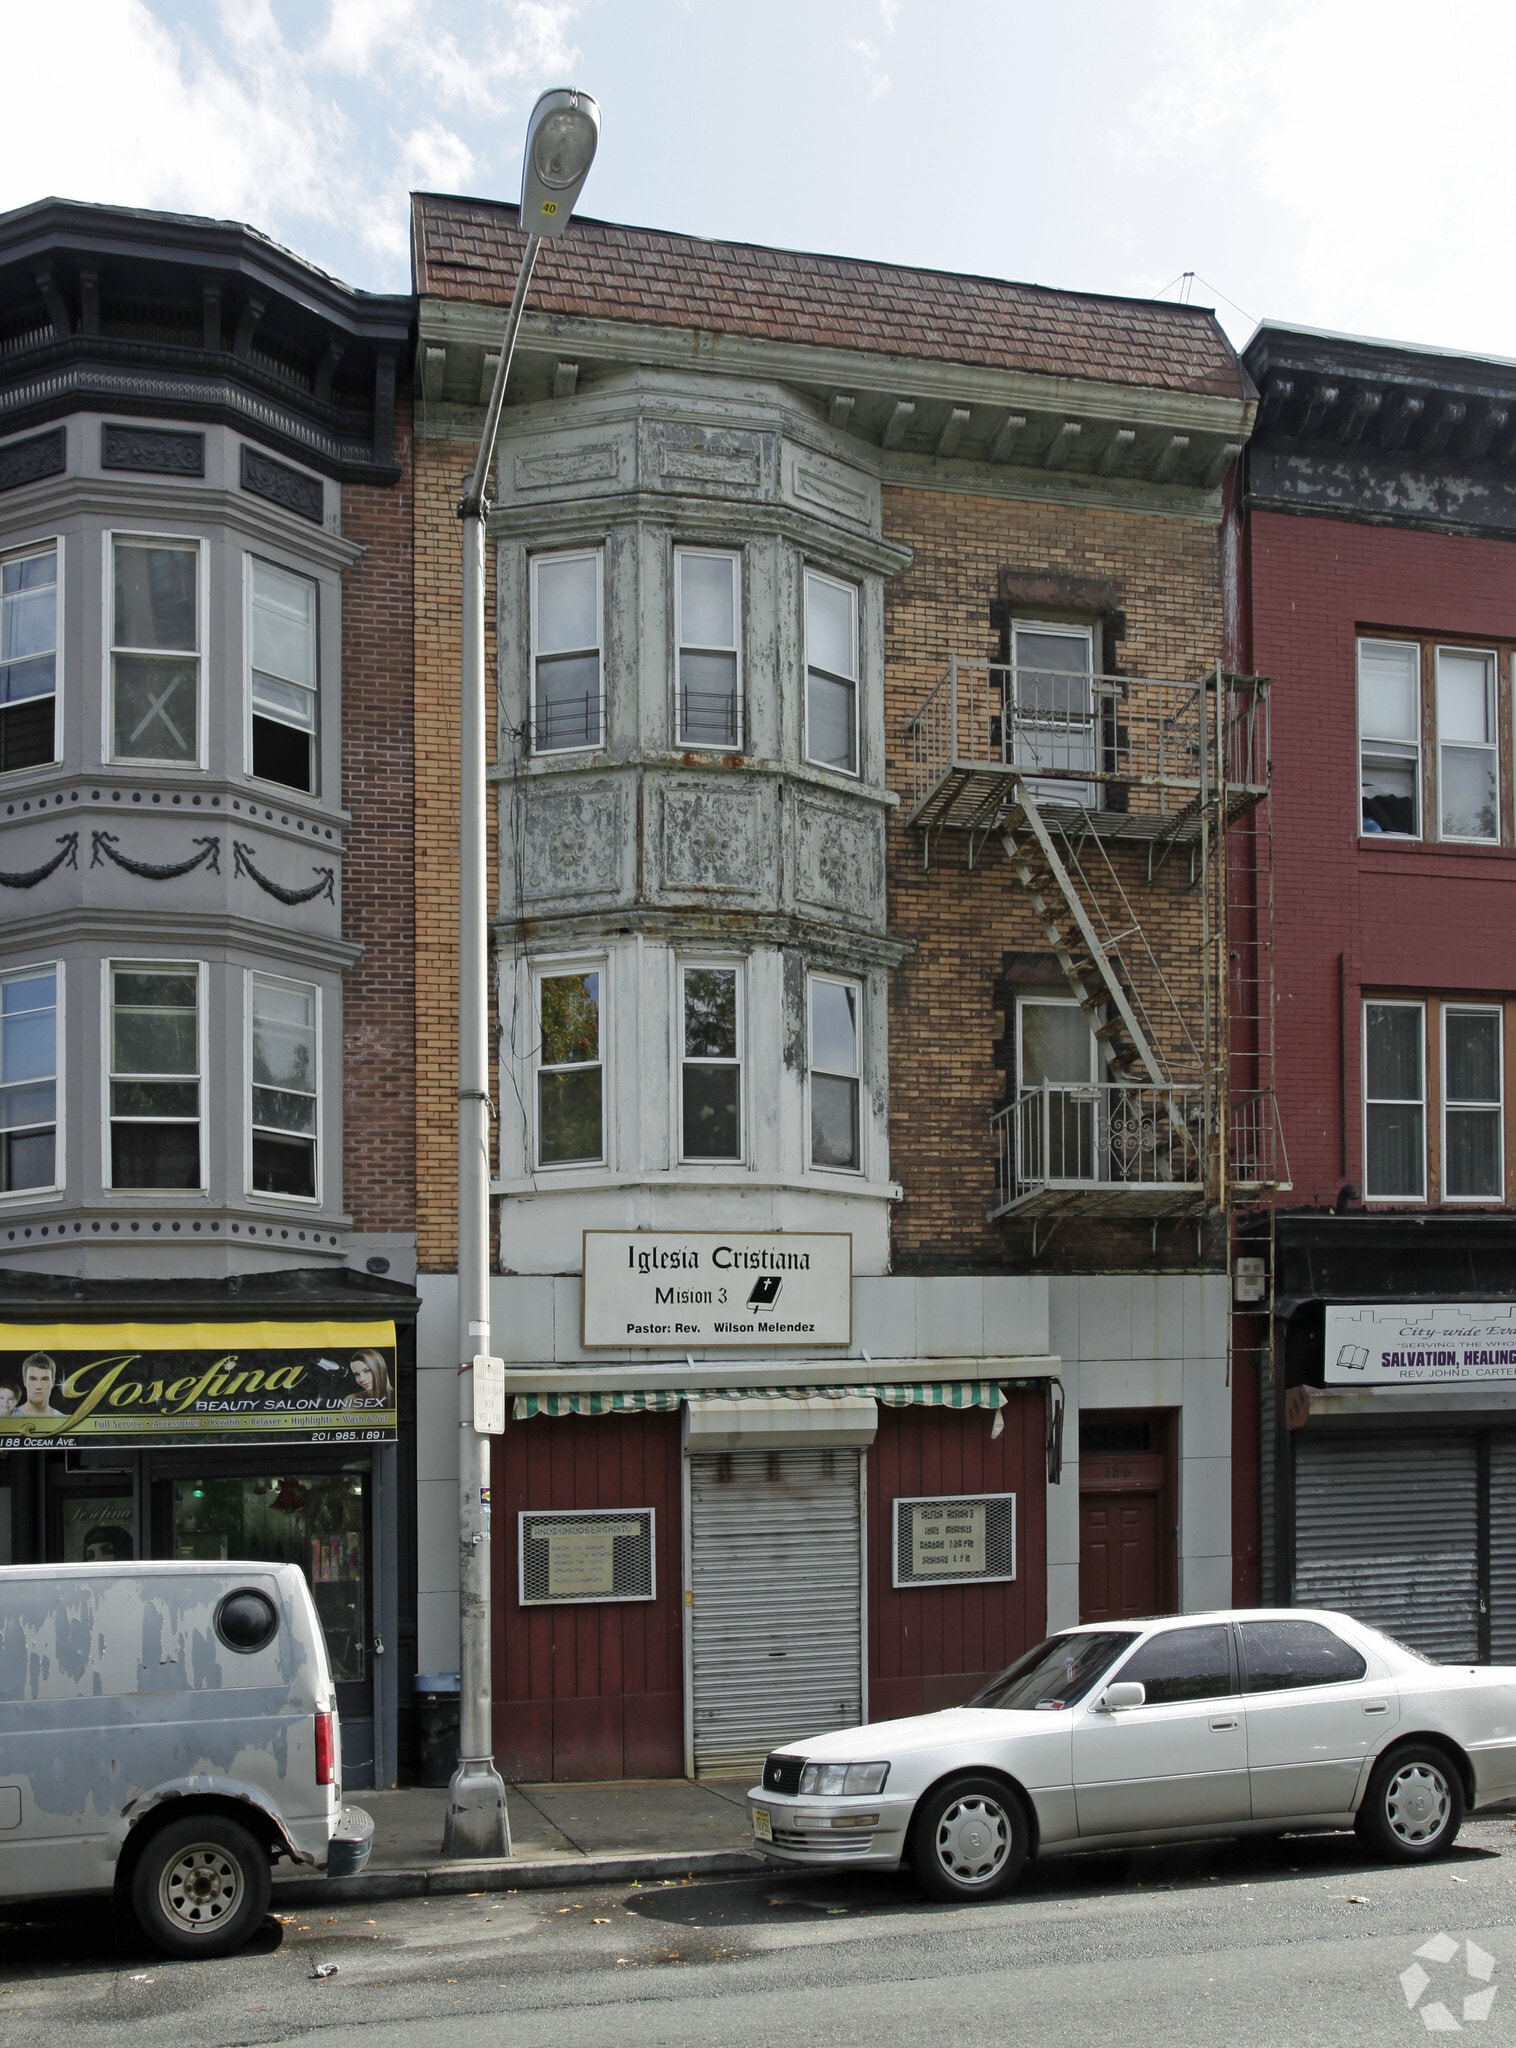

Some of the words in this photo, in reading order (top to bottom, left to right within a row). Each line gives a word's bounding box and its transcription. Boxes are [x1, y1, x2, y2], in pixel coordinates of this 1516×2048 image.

[542, 203, 556, 214] 40
[628, 1245, 699, 1274] Iglesia
[711, 1245, 811, 1271] Cristiana
[655, 1286, 712, 1304] Mision
[718, 1287, 728, 1304] 3
[626, 1323, 671, 1334] Pastor:
[675, 1323, 700, 1333] Rev.
[714, 1322, 754, 1333] Wilson
[758, 1322, 815, 1332] Melendez
[1399, 1326, 1481, 1339] City-wide
[1486, 1340, 1516, 1348] WHO
[1381, 1351, 1460, 1369] SALVATION,
[1399, 1370, 1425, 1378] REV.
[1429, 1369, 1460, 1378] JOHN
[1475, 1368, 1516, 1377] CARTE
[21, 1354, 308, 1438] Josefina
[195, 1400, 260, 1412] BEAUTY
[263, 1399, 320, 1410] SALON
[326, 1397, 387, 1409] UNISEX
[94, 1420, 110, 1429] Full
[112, 1420, 143, 1429] Service
[250, 1417, 281, 1426] Relaxer
[291, 1415, 333, 1427] Highlights
[342, 1415, 364, 1424] Wash
[23, 1437, 54, 1447] OCEAN
[311, 1431, 386, 1441] 201.985.1891
[68, 1504, 132, 1526] Josefina
